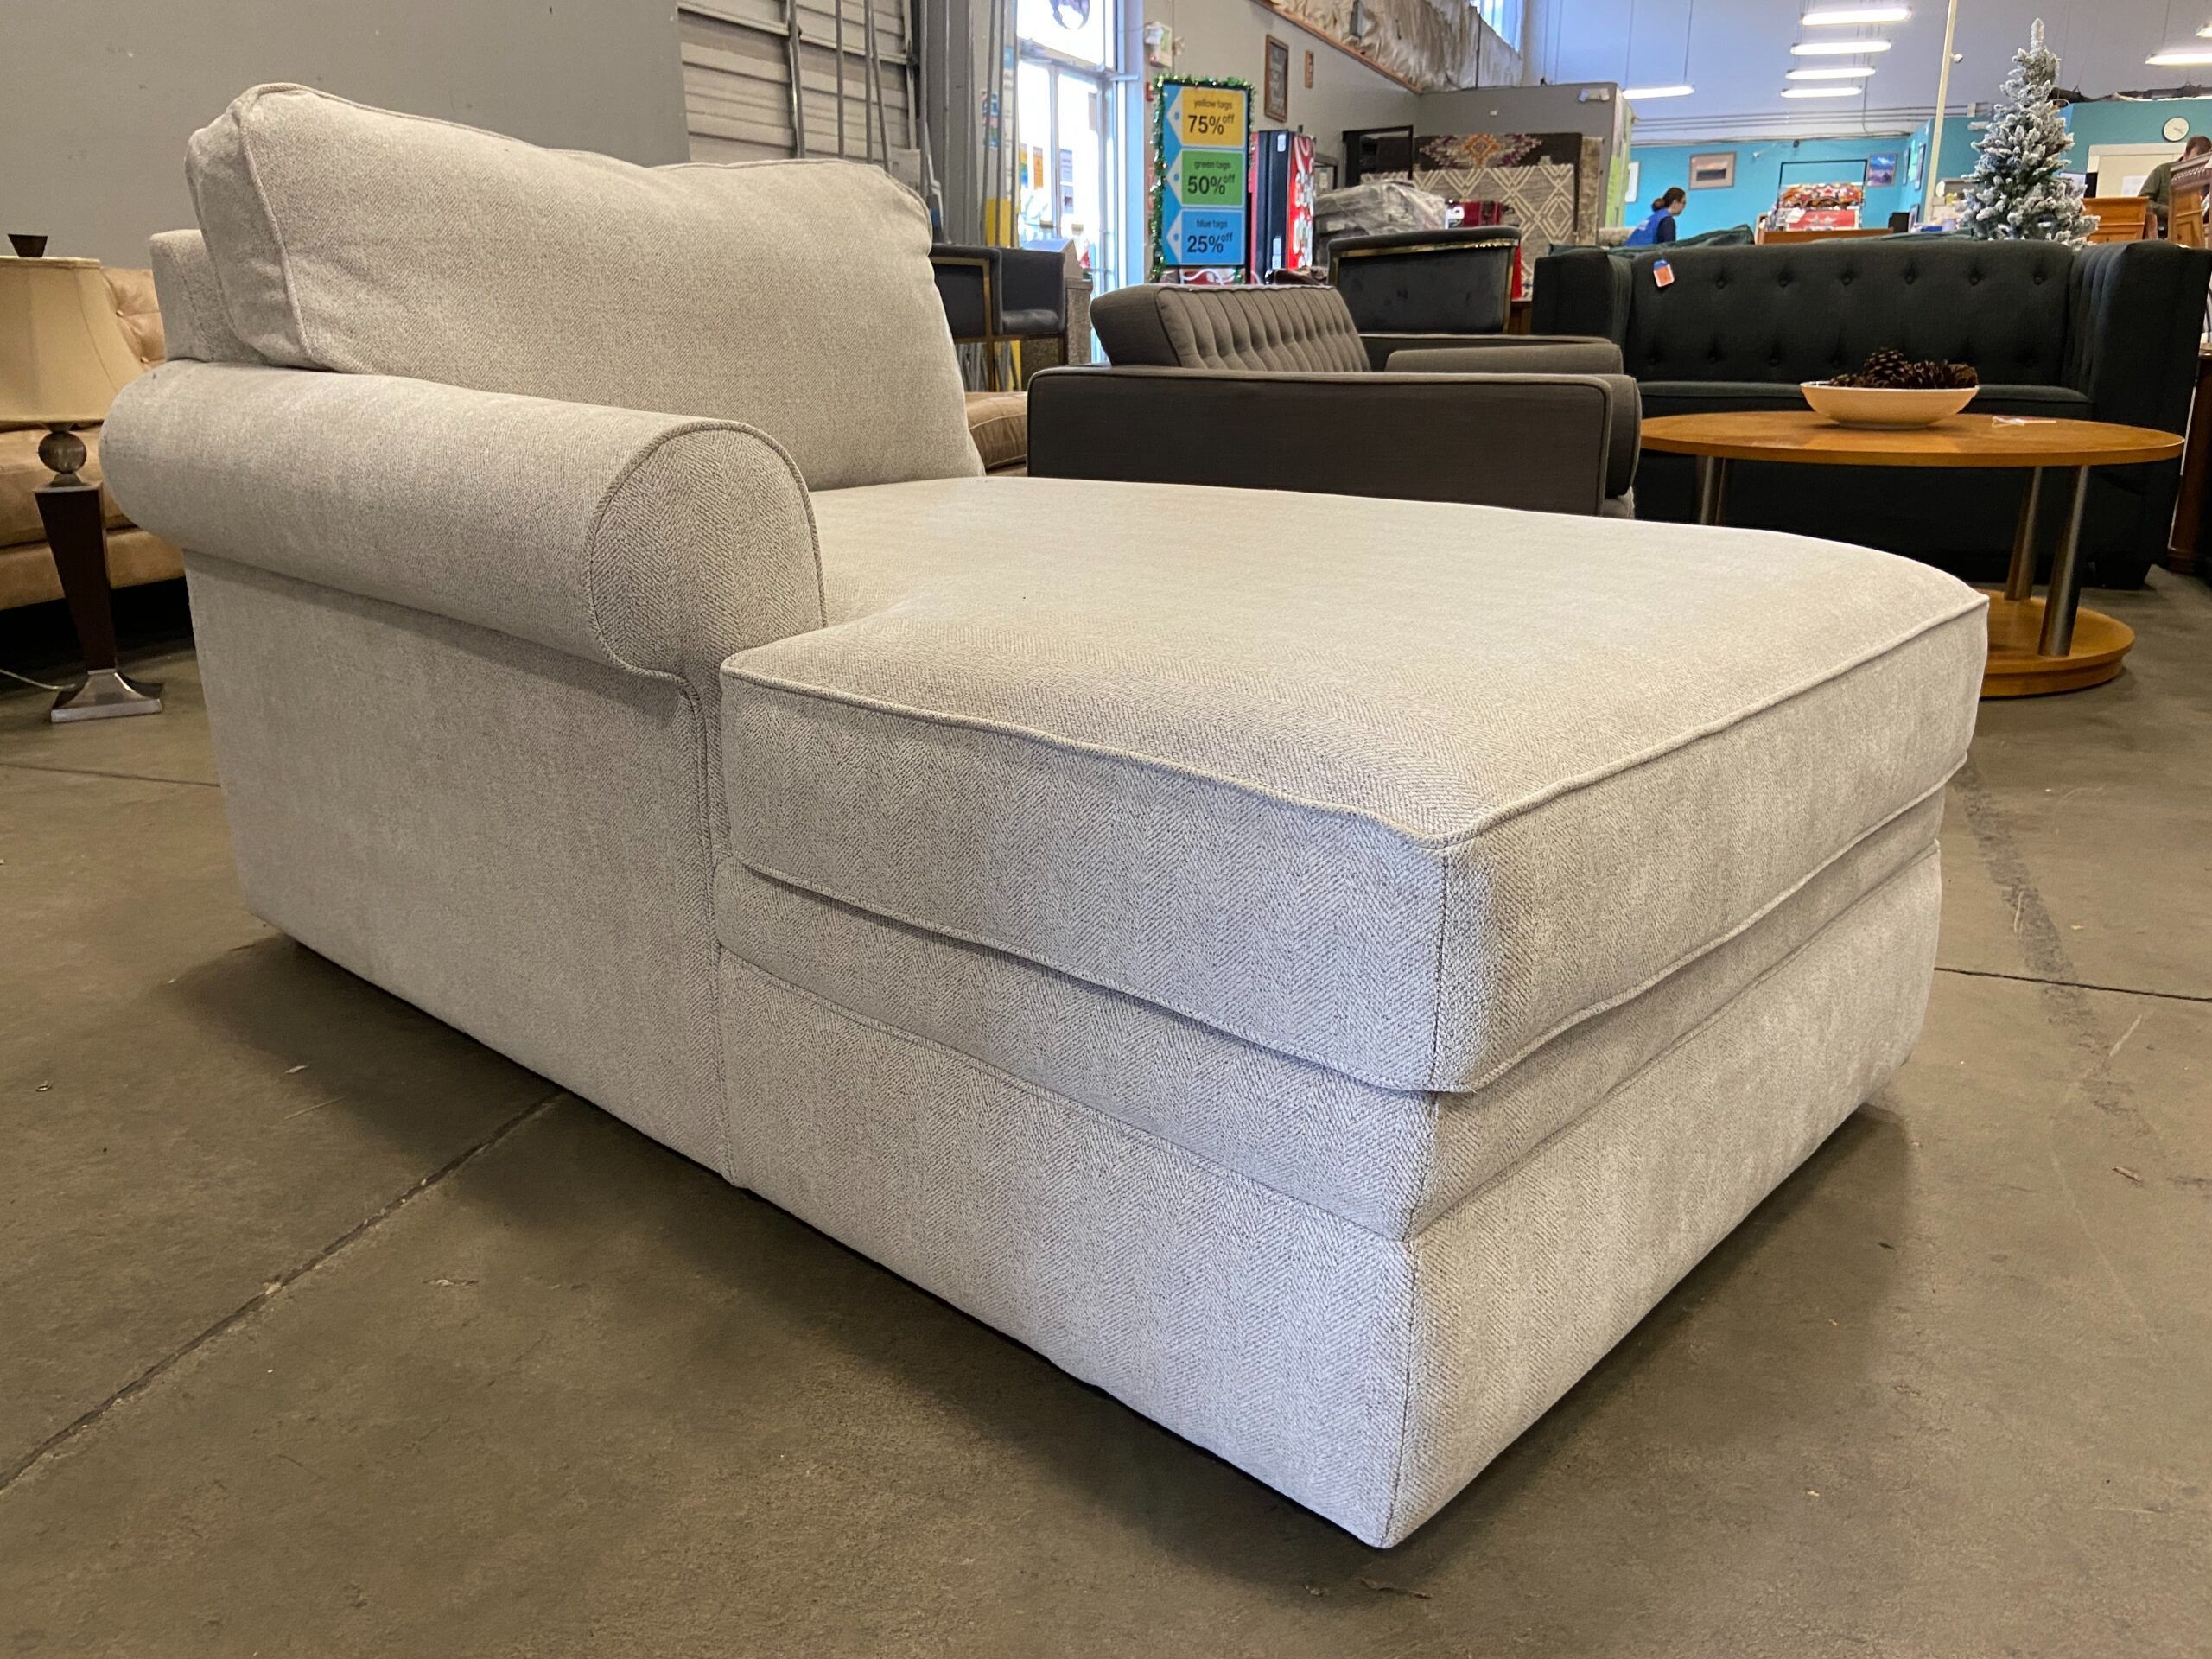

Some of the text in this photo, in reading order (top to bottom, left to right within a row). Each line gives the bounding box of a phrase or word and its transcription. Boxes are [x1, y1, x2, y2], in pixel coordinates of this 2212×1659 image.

[1217, 99, 1232, 110] tags
[1188, 114, 1235, 135] 75% off
[1215, 162, 1230, 171] tags
[1187, 174, 1235, 194] 50% off
[1196, 219, 1228, 229] blue tags
[1187, 232, 1233, 252] 25% off
